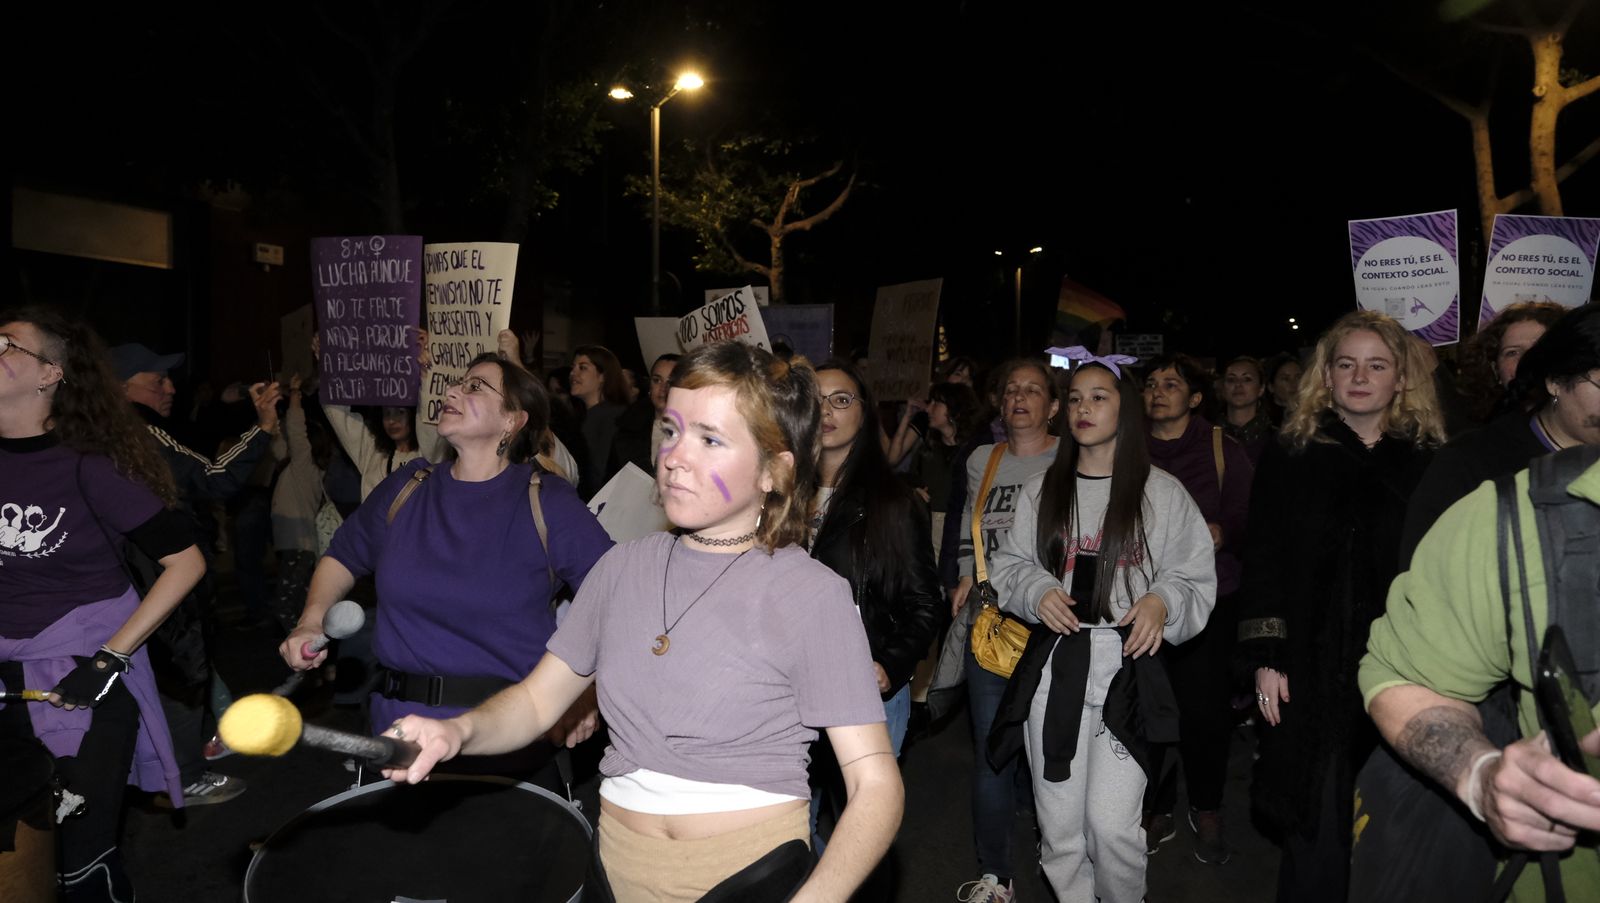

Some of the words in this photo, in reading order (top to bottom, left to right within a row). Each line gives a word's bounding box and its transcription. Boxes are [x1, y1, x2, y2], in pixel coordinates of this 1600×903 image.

[450, 249, 468, 270] QUE
[471, 249, 485, 270] EL
[1364, 259, 1378, 267] NO
[1380, 258, 1401, 267] ERES
[1403, 254, 1418, 265] TÚ,
[1420, 254, 1431, 263] ES
[1433, 253, 1444, 262] EL
[1501, 253, 1516, 262] NO
[1518, 254, 1540, 262] ERES
[1542, 253, 1556, 264] TÚ,
[1558, 256, 1569, 264] ES
[1571, 256, 1581, 265] EL
[318, 260, 368, 287] LUCHA
[370, 258, 414, 284] AUNQUE
[1361, 270, 1409, 280] CONTEXTO
[1411, 266, 1449, 278] SOCIAL.
[1495, 266, 1545, 276] CONTEXTO
[1547, 268, 1584, 278] SOCIAL.
[468, 279, 484, 306] NO
[486, 278, 503, 305] TE
[326, 299, 346, 319] NO
[350, 298, 366, 319] TE
[369, 296, 406, 319] FALTE
[680, 314, 698, 344] NO
[701, 290, 745, 331] SOMOS
[429, 310, 482, 337] REPRESENTA
[485, 311, 493, 337] Y
[326, 325, 360, 350] NADA
[365, 324, 412, 349] PORQUE
[323, 352, 333, 374] A
[338, 352, 391, 375] ALGUNAS
[430, 342, 472, 368] GRACIAS
[328, 377, 367, 400] FALTA
